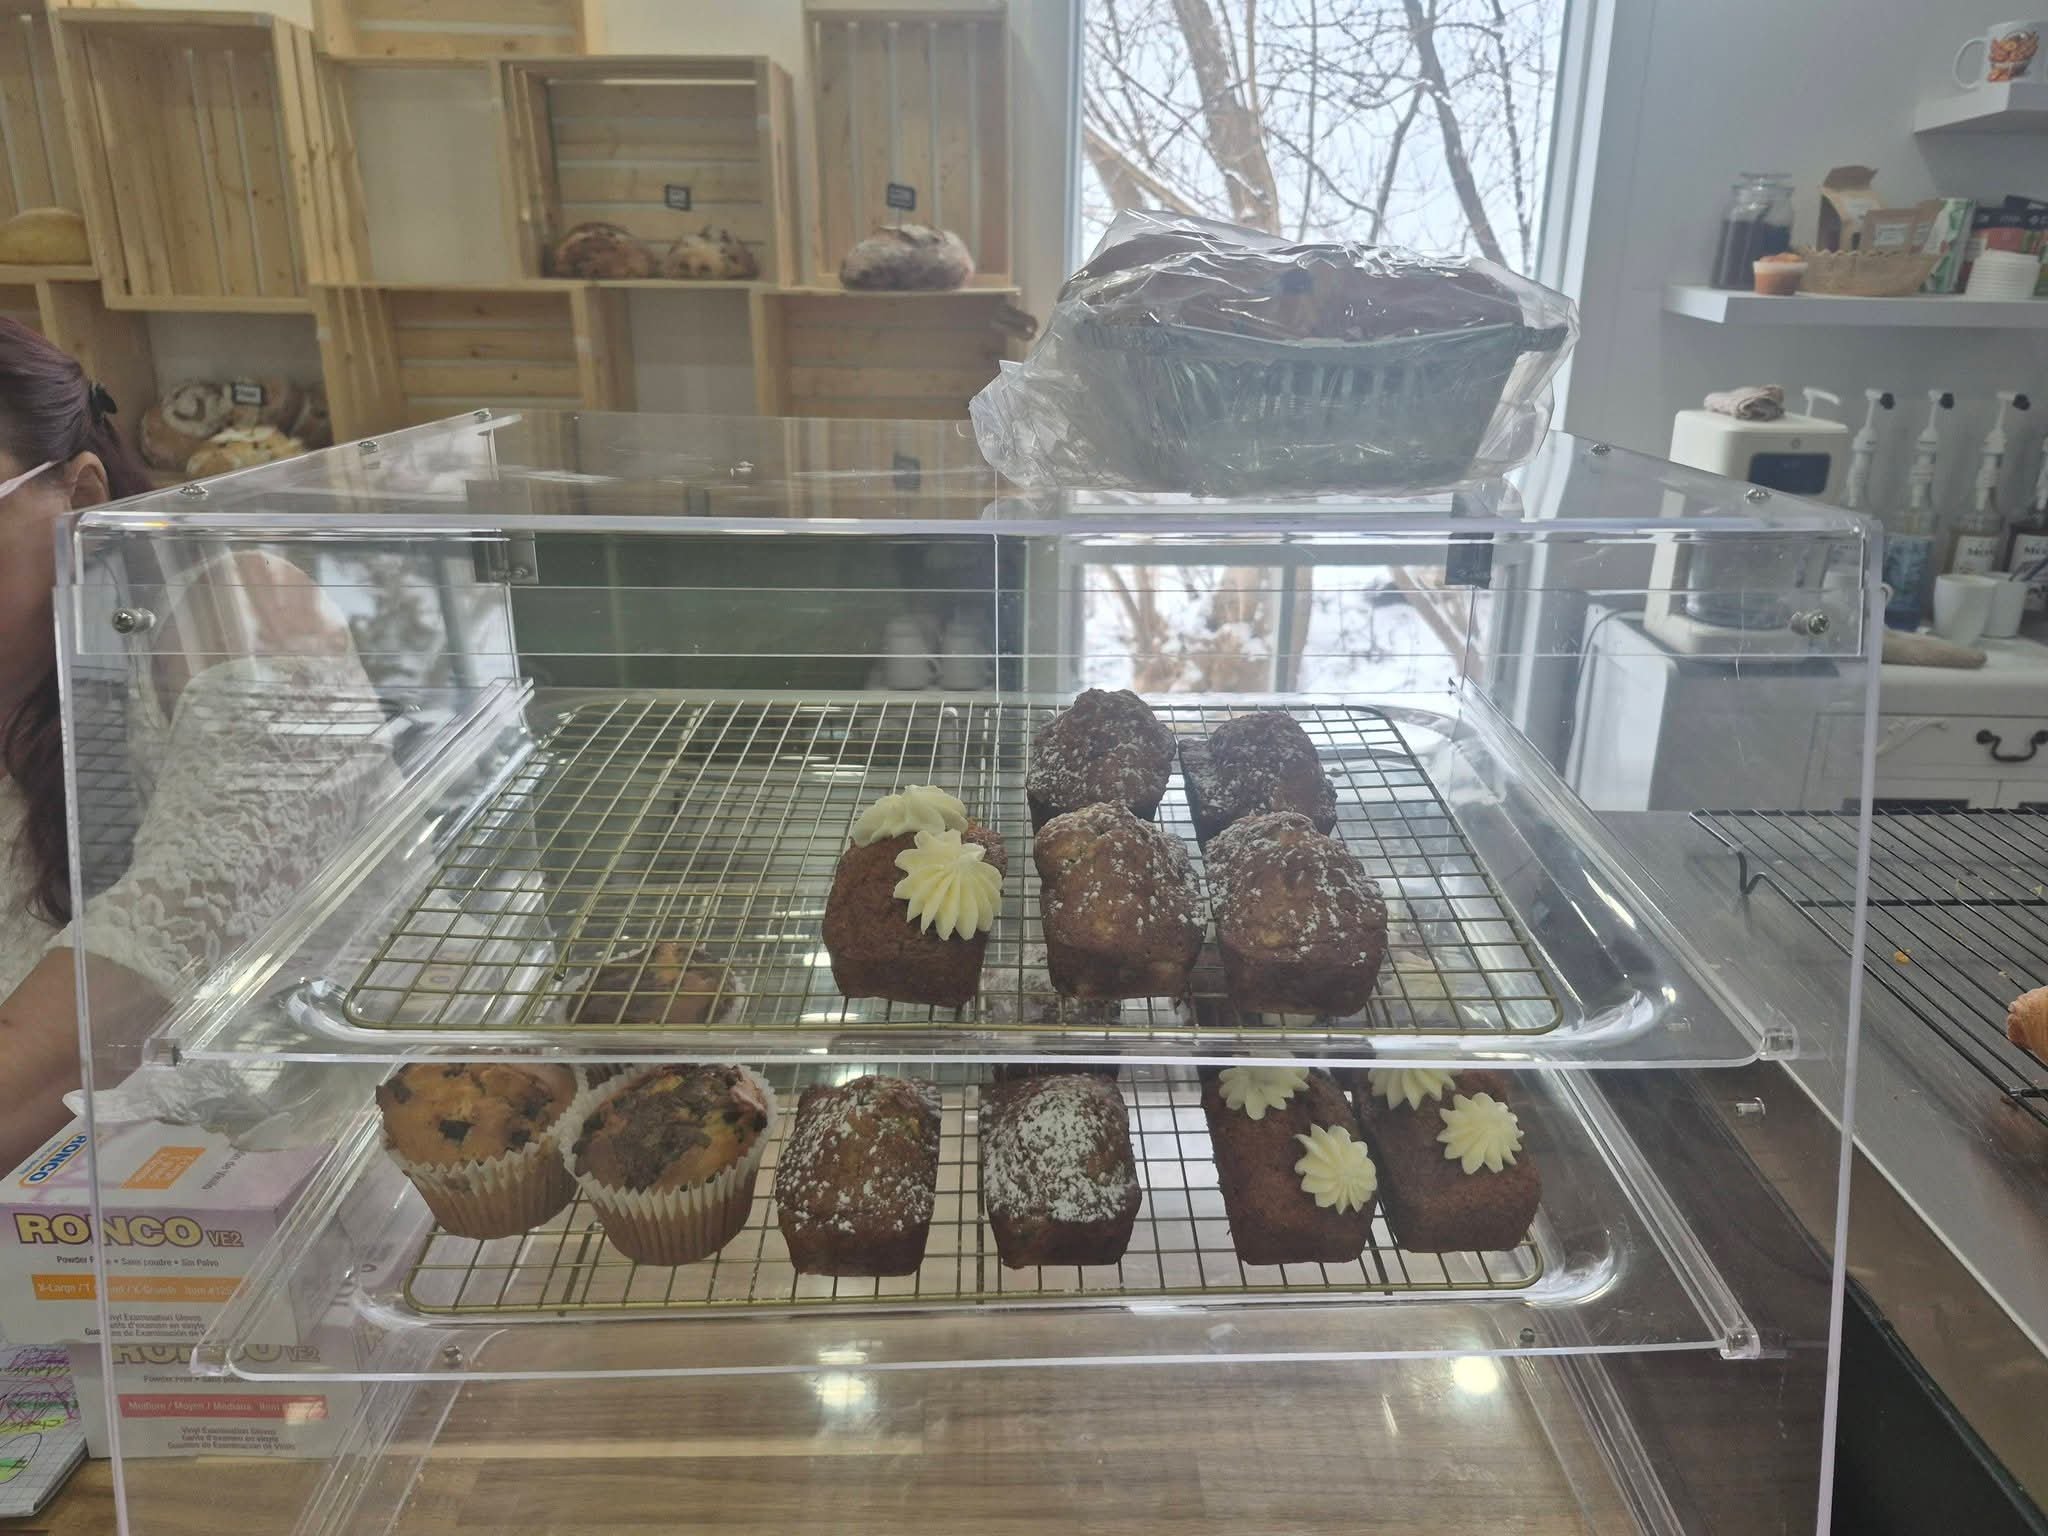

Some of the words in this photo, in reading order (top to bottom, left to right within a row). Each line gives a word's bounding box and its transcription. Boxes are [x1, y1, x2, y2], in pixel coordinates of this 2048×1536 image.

[28, 1135, 88, 1182] RONCO
[14, 1213, 203, 1247] RONCO
[206, 1230, 245, 1247] VE2
